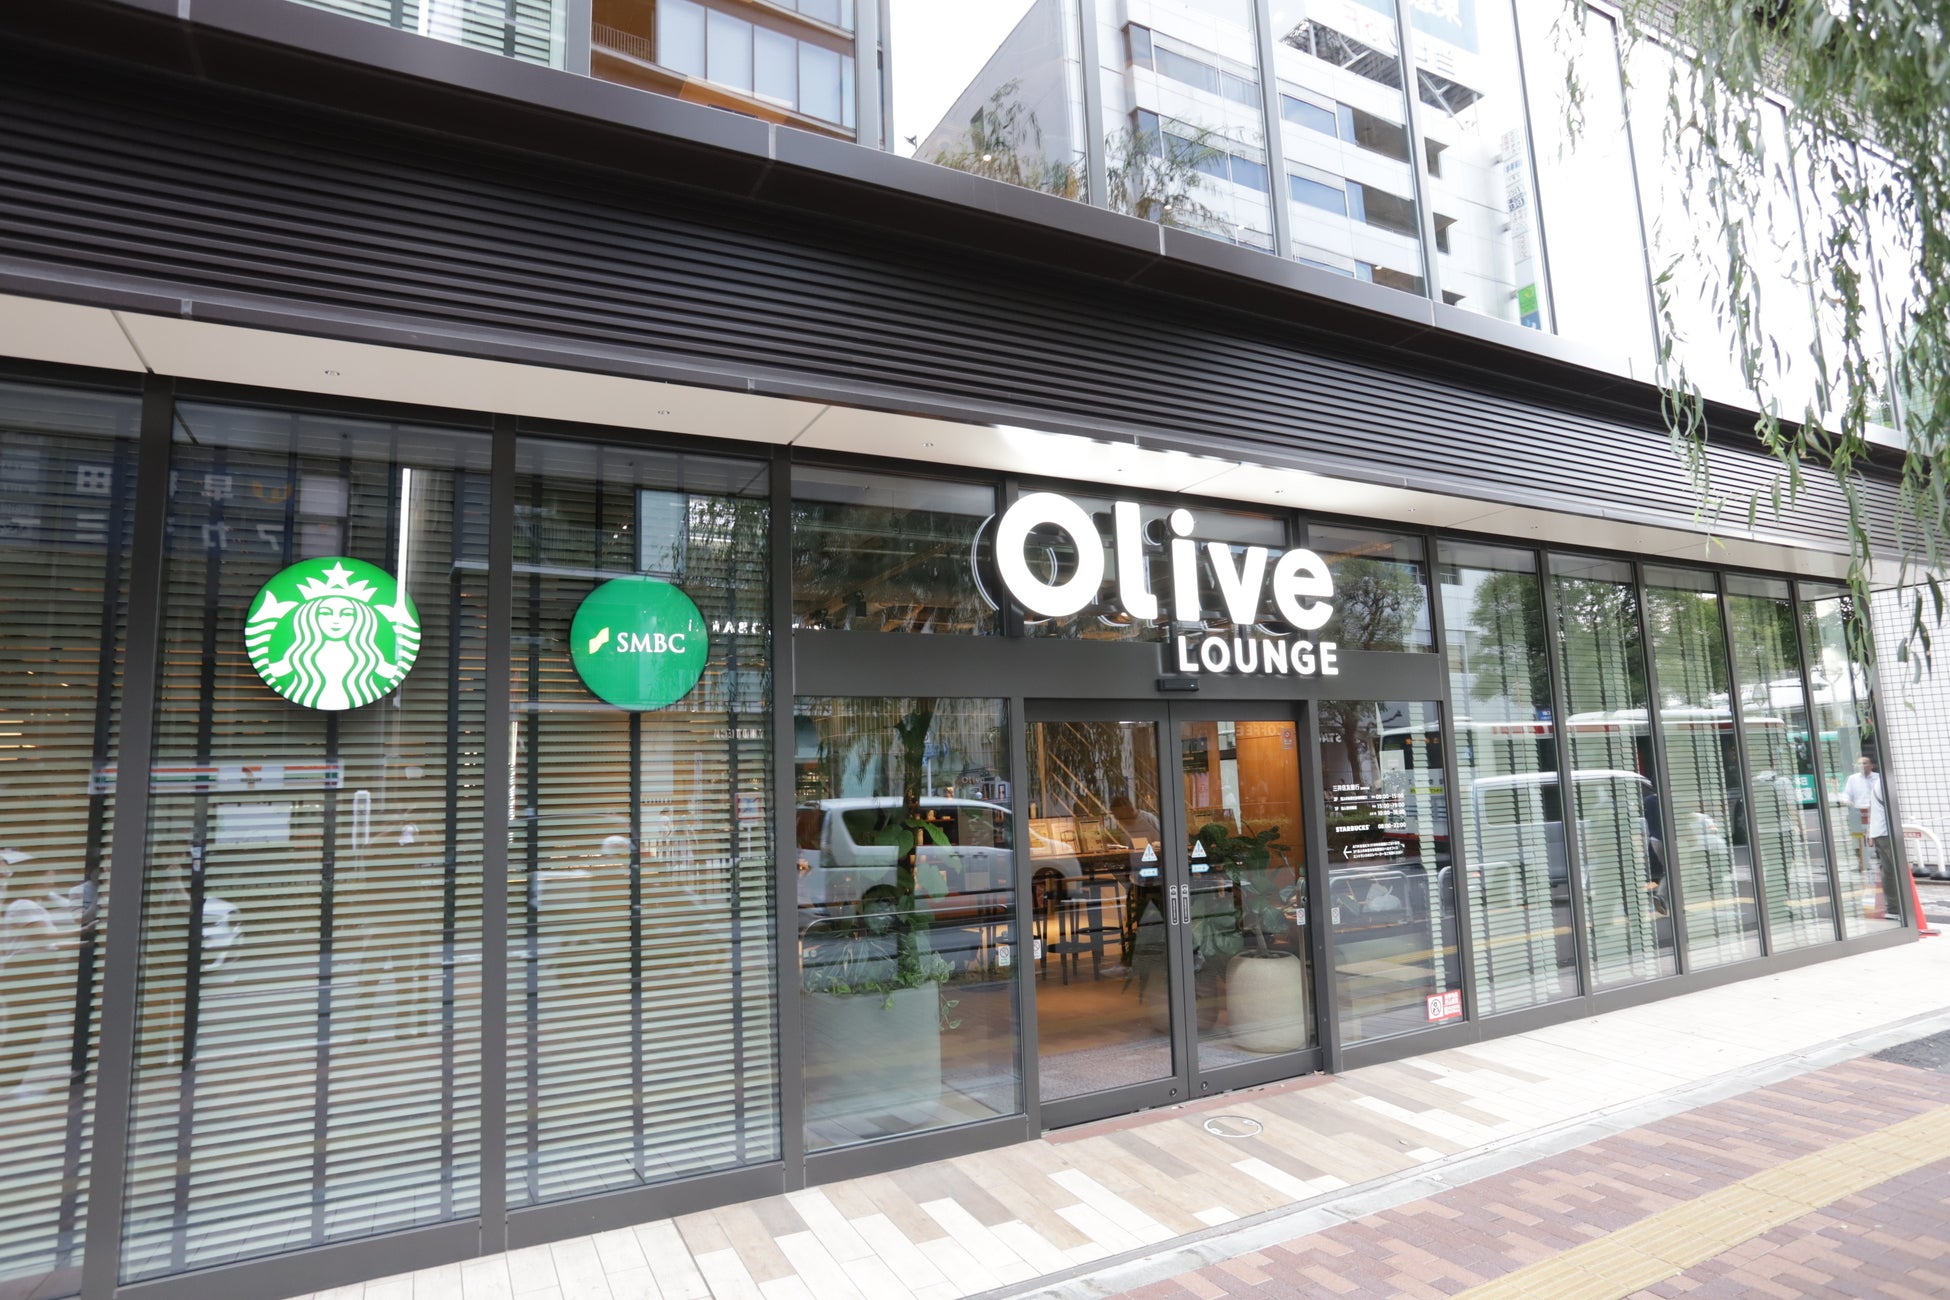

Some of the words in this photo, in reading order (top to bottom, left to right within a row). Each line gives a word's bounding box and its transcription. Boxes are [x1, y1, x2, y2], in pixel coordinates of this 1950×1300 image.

[996, 492, 1334, 630] Olive
[617, 632, 686, 654] SMBC
[1178, 636, 1339, 675] LOUNGE
